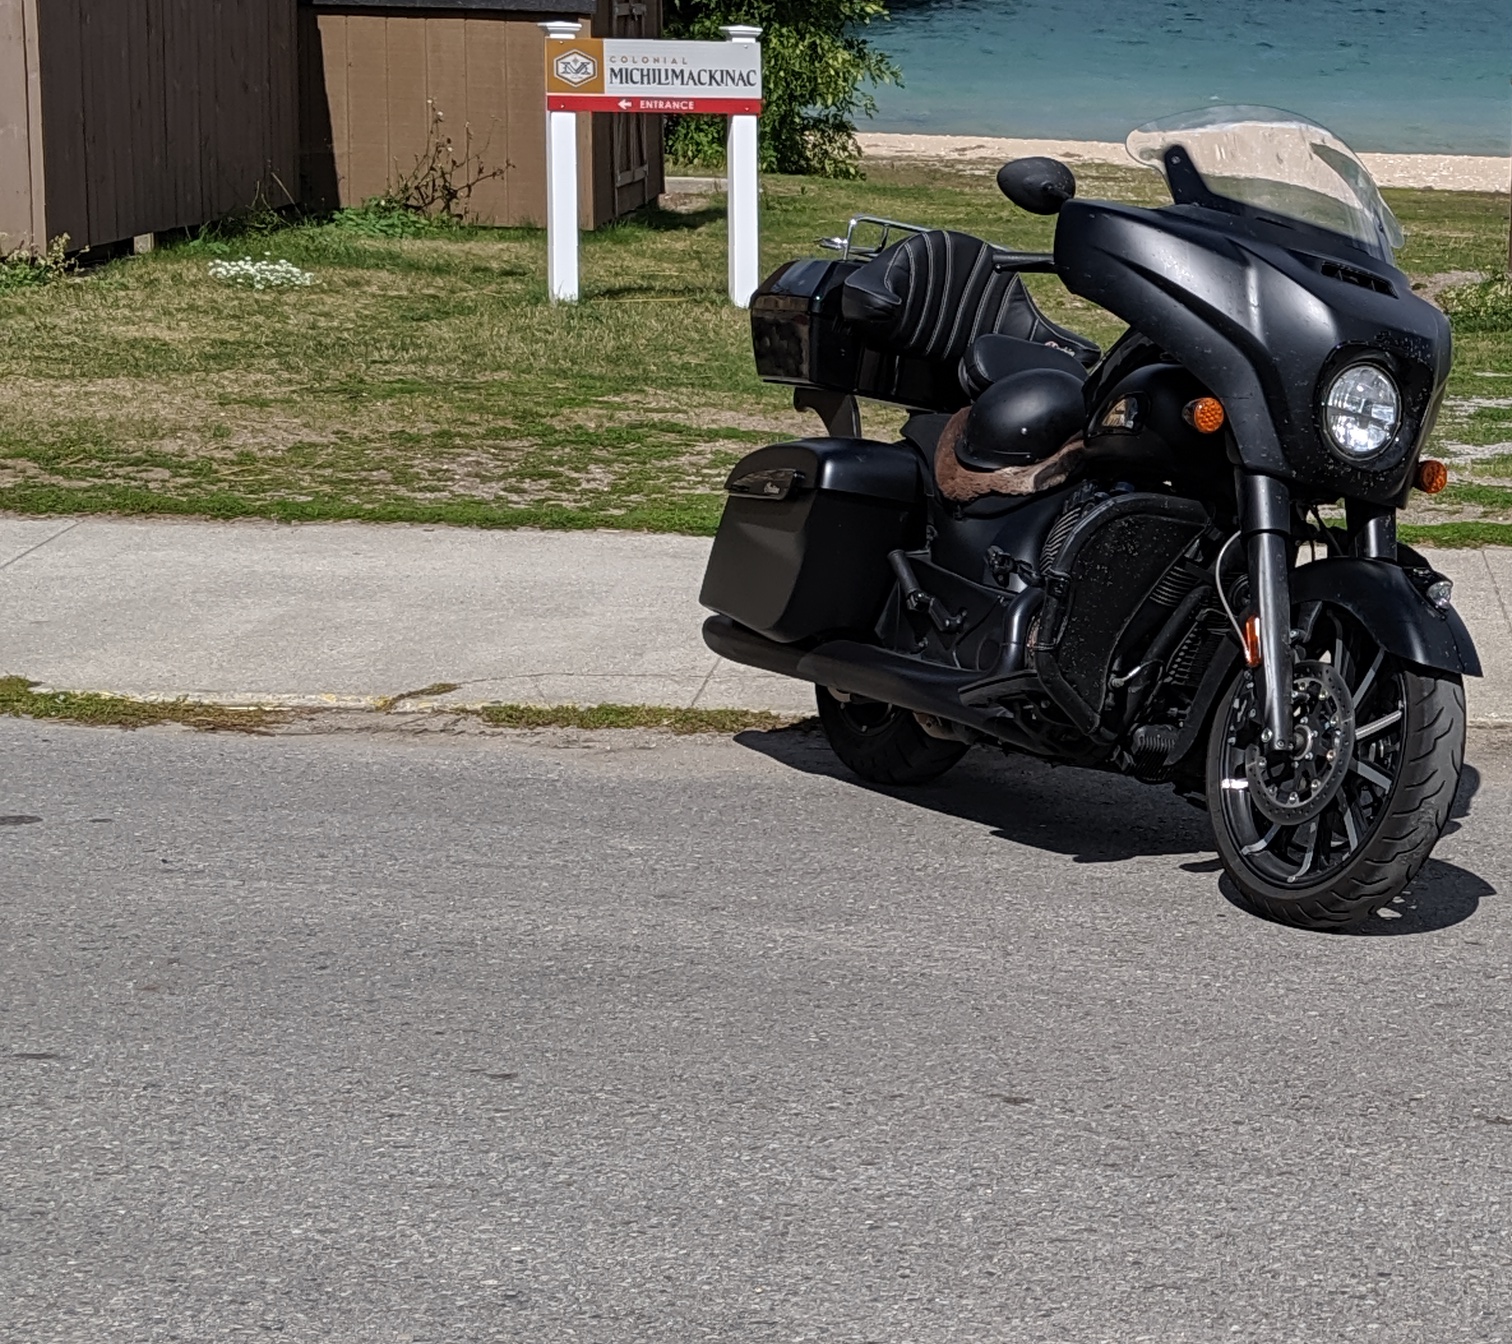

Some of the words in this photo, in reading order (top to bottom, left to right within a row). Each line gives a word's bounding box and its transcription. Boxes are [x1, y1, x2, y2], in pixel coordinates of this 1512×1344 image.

[609, 55, 688, 66] COLONIAL
[609, 67, 758, 87] MICHILIMACKINAC
[639, 99, 695, 110] ENTRANCE
